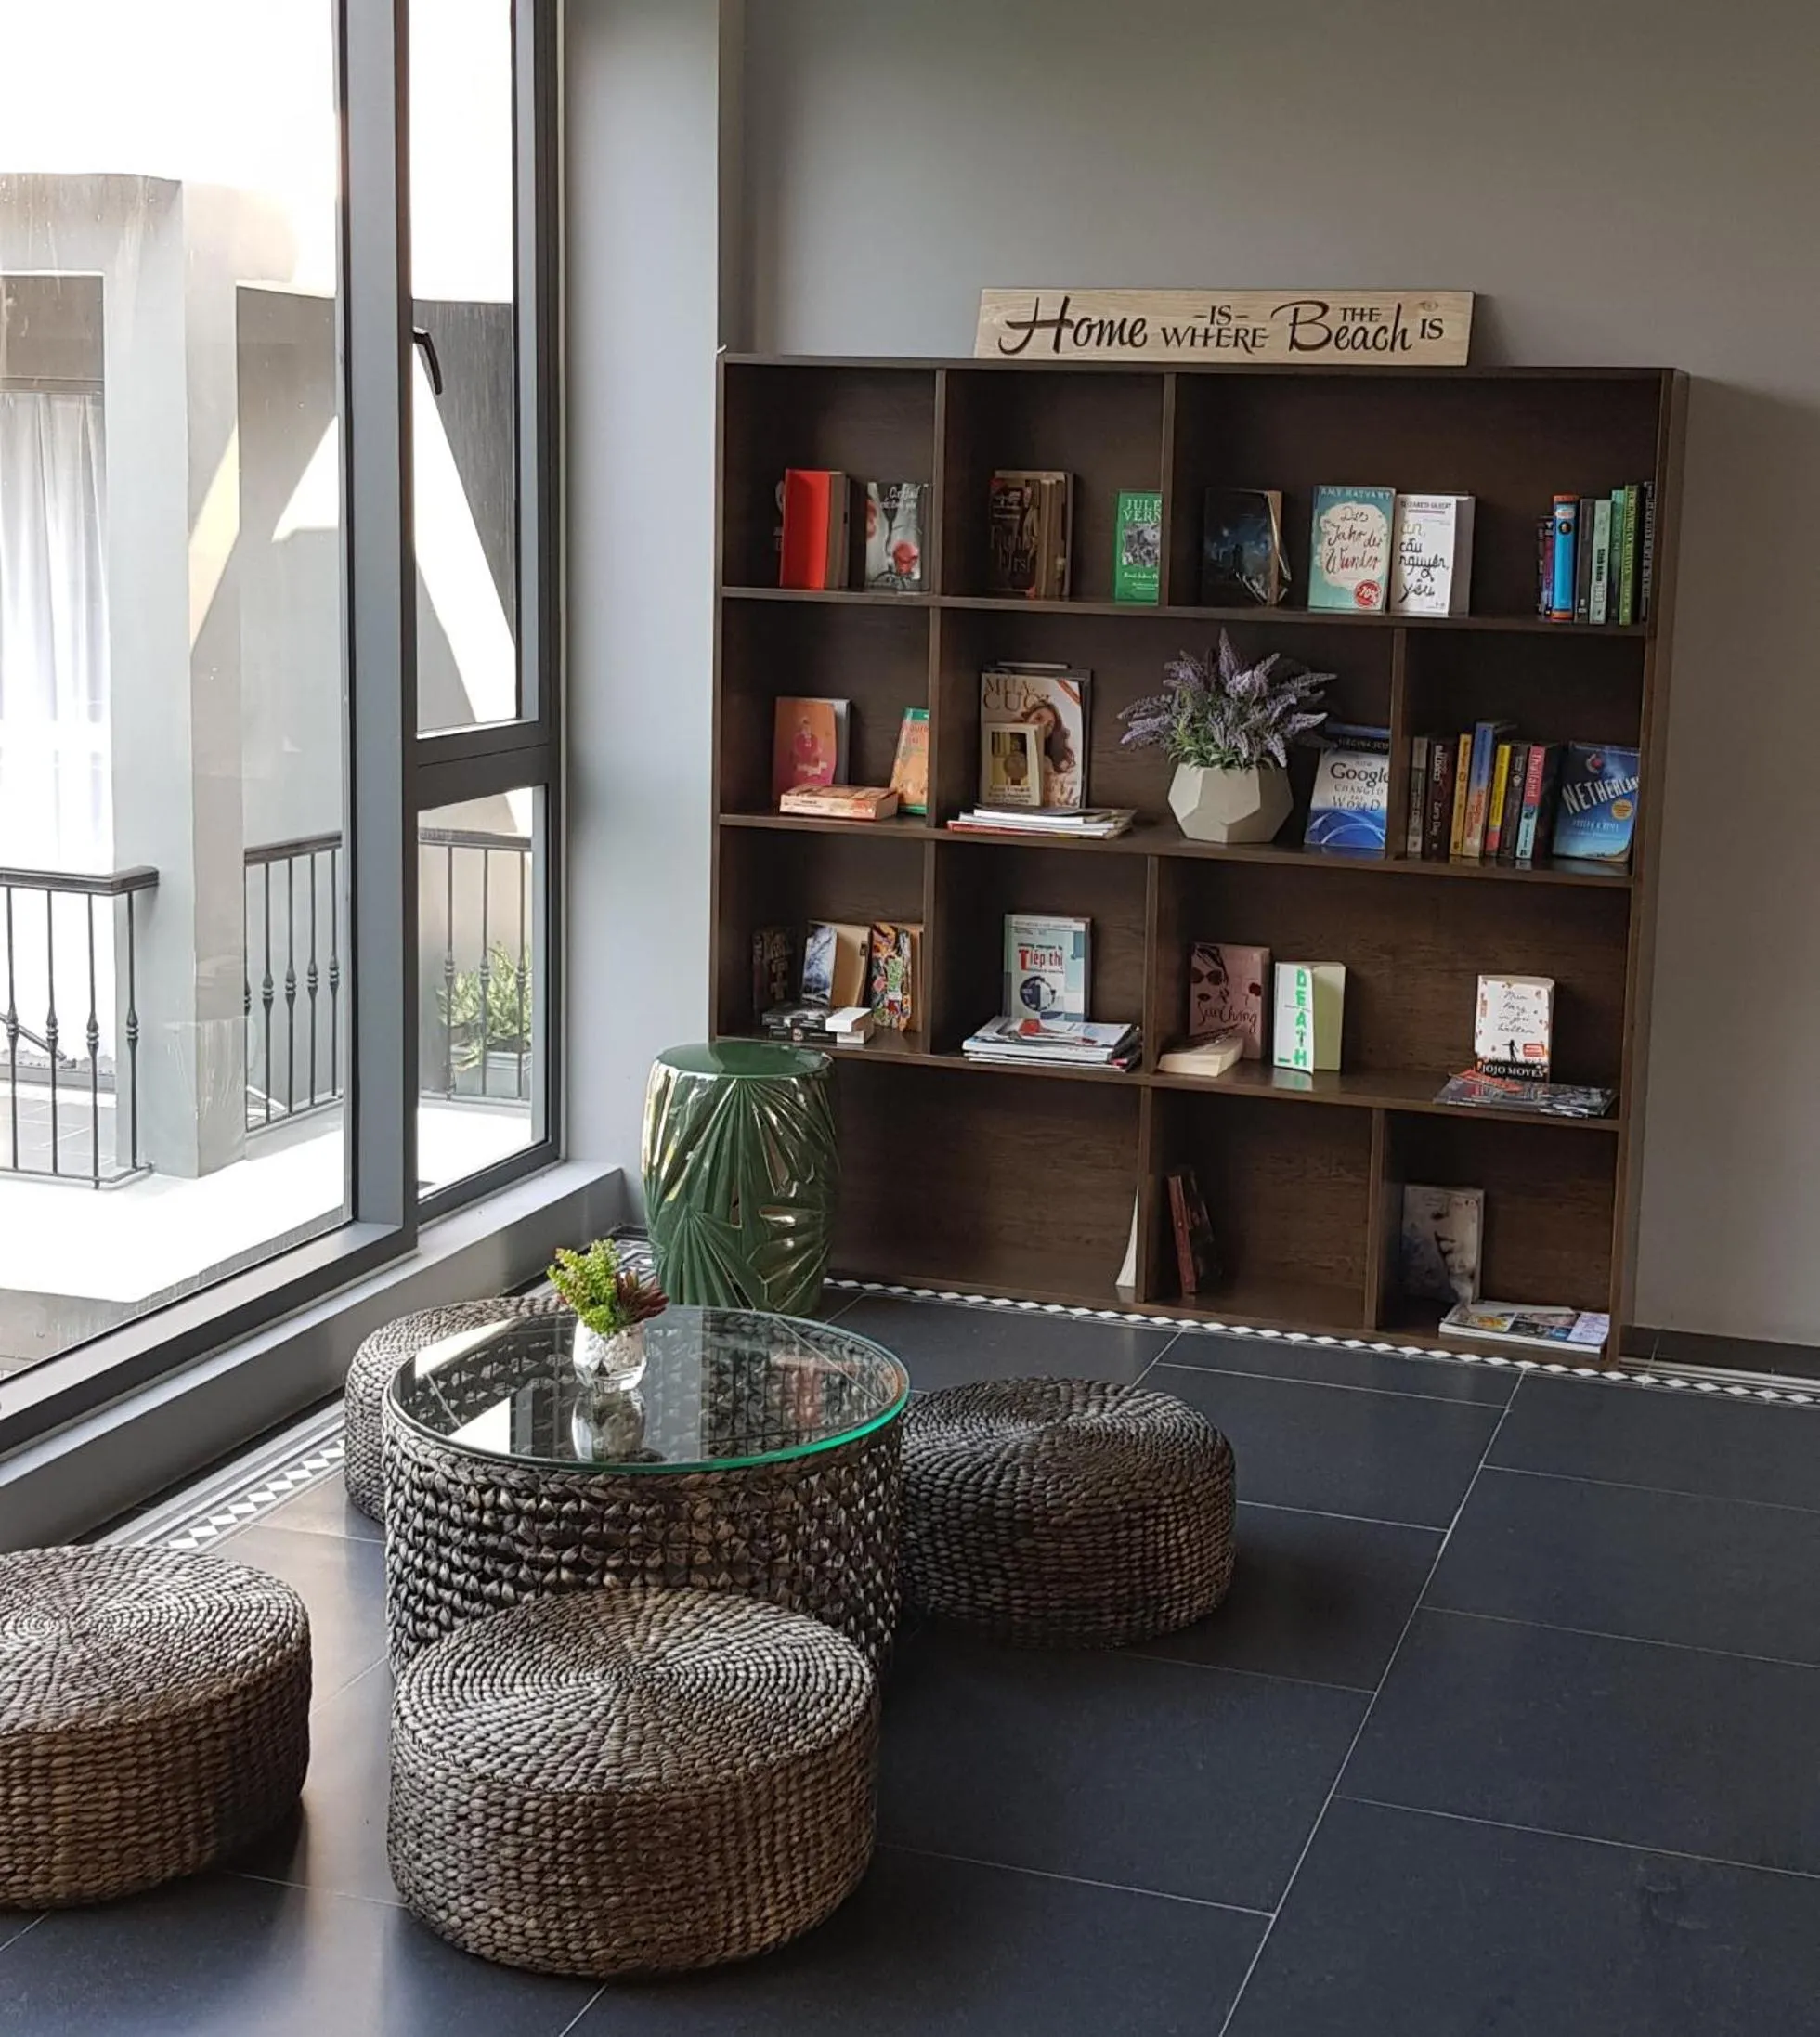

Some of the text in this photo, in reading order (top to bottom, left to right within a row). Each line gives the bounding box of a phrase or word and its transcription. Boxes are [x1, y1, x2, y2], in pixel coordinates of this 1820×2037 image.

[998, 296, 1148, 355] Home
[1270, 300, 1413, 353] Beach
[1340, 307, 1382, 323] THE
[1161, 325, 1269, 356] WHERE
[1419, 317, 1444, 340] IS
[1321, 487, 1341, 498] AMY
[1123, 510, 1162, 522] VERN
[1124, 500, 1162, 511] JULE
[1325, 547, 1381, 574] Wunder
[1527, 753, 1542, 798] Thailand
[1332, 796, 1381, 811] WORLD
[1562, 776, 1639, 815] NETHERLAN
[1294, 969, 1307, 1067] DEATH
[1482, 1065, 1544, 1078] JOJO MOYES
